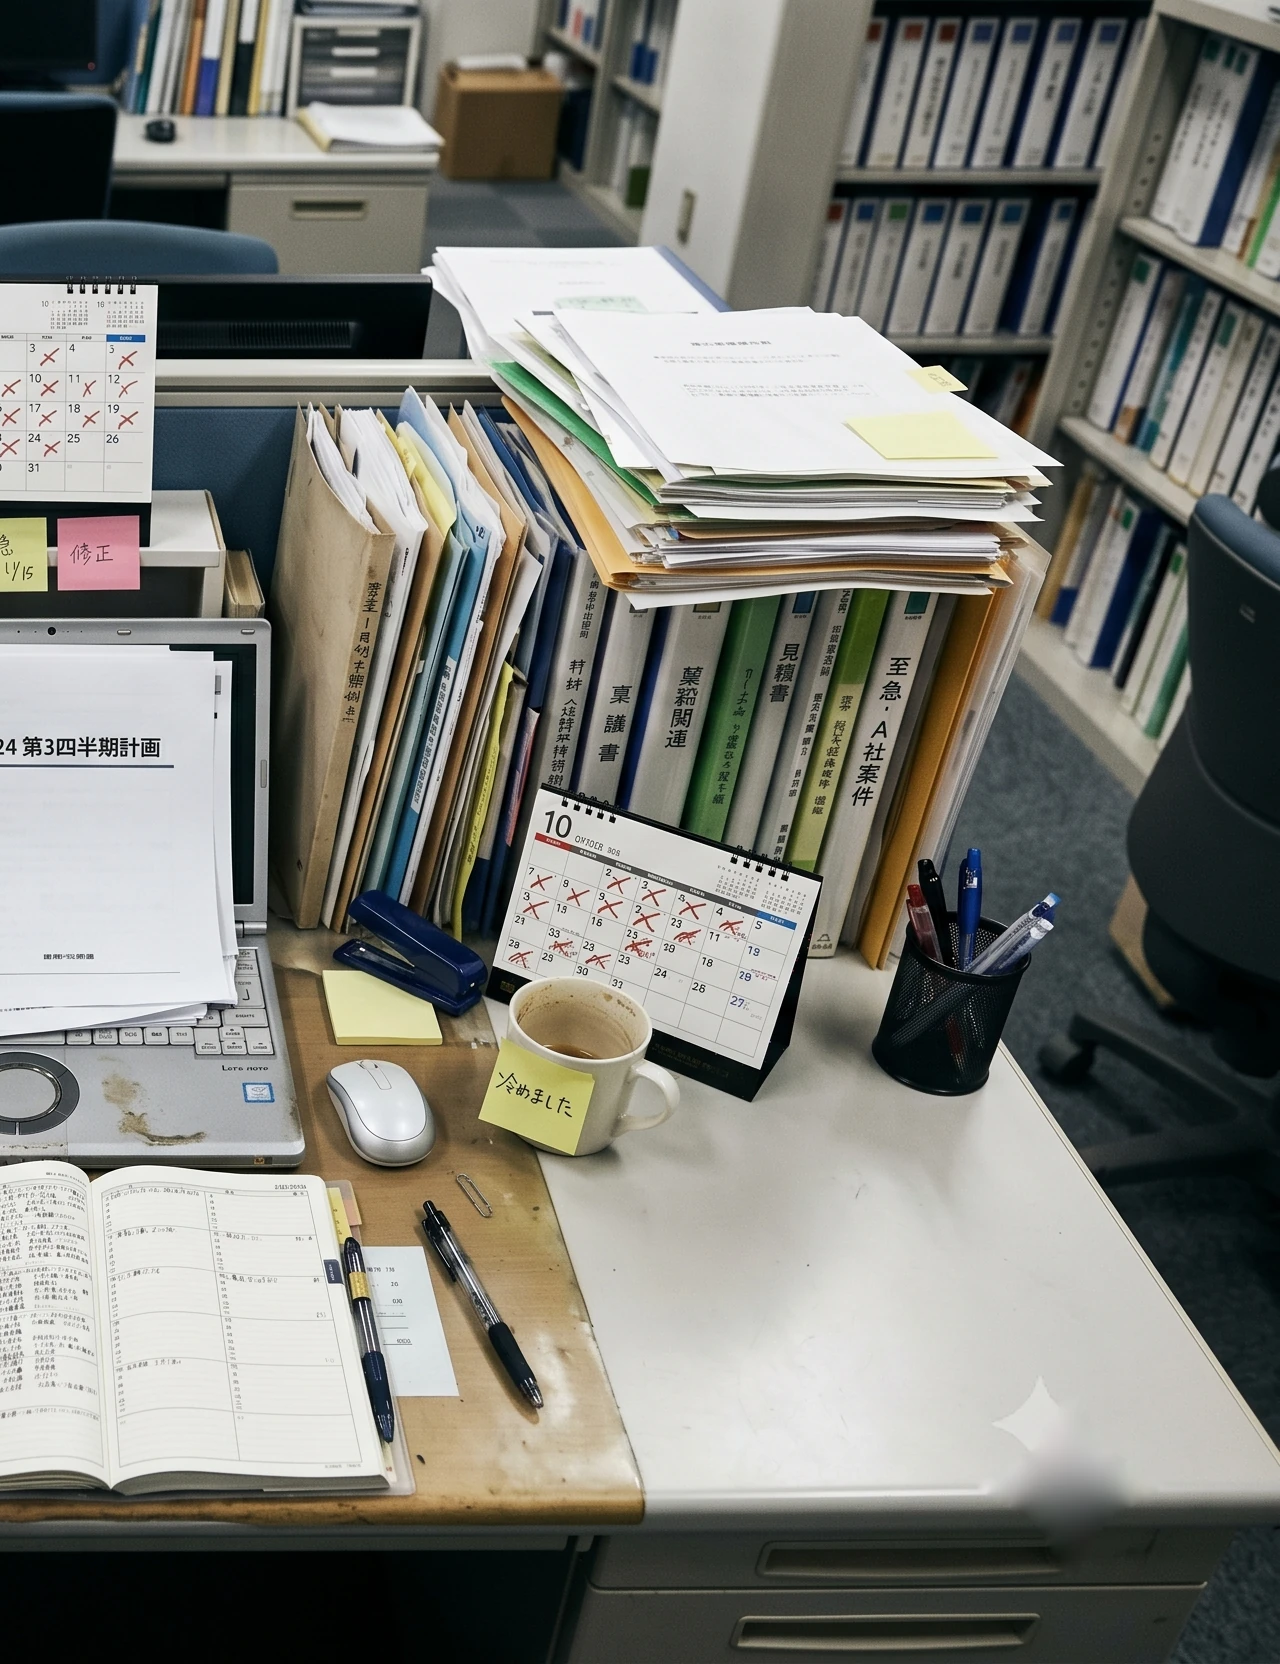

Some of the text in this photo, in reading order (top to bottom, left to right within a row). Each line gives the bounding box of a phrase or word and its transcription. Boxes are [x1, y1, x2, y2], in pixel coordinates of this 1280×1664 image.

[28, 343, 37, 354] 3
[68, 343, 76, 354] 4
[29, 373, 42, 384] 10
[68, 374, 81, 384] 11
[108, 374, 120, 385] 12
[29, 403, 41, 413] 17
[68, 403, 81, 414] 18
[107, 403, 120, 414] 19
[28, 433, 41, 443] 24
[67, 433, 81, 444] 25
[106, 433, 120, 444] 26
[27, 462, 40, 473] 31
[70, 544, 114, 566] 修正
[22, 735, 161, 759] 第3四半期計画
[545, 810, 572, 838] 10
[529, 867, 534, 875] 7
[670, 918, 683, 929] 23
[716, 907, 724, 916] 4
[701, 957, 713, 968] 18
[576, 965, 589, 976] 30
[654, 968, 667, 979] 24
[730, 995, 745, 1008] 27
[495, 1072, 573, 1118] 冷めました
